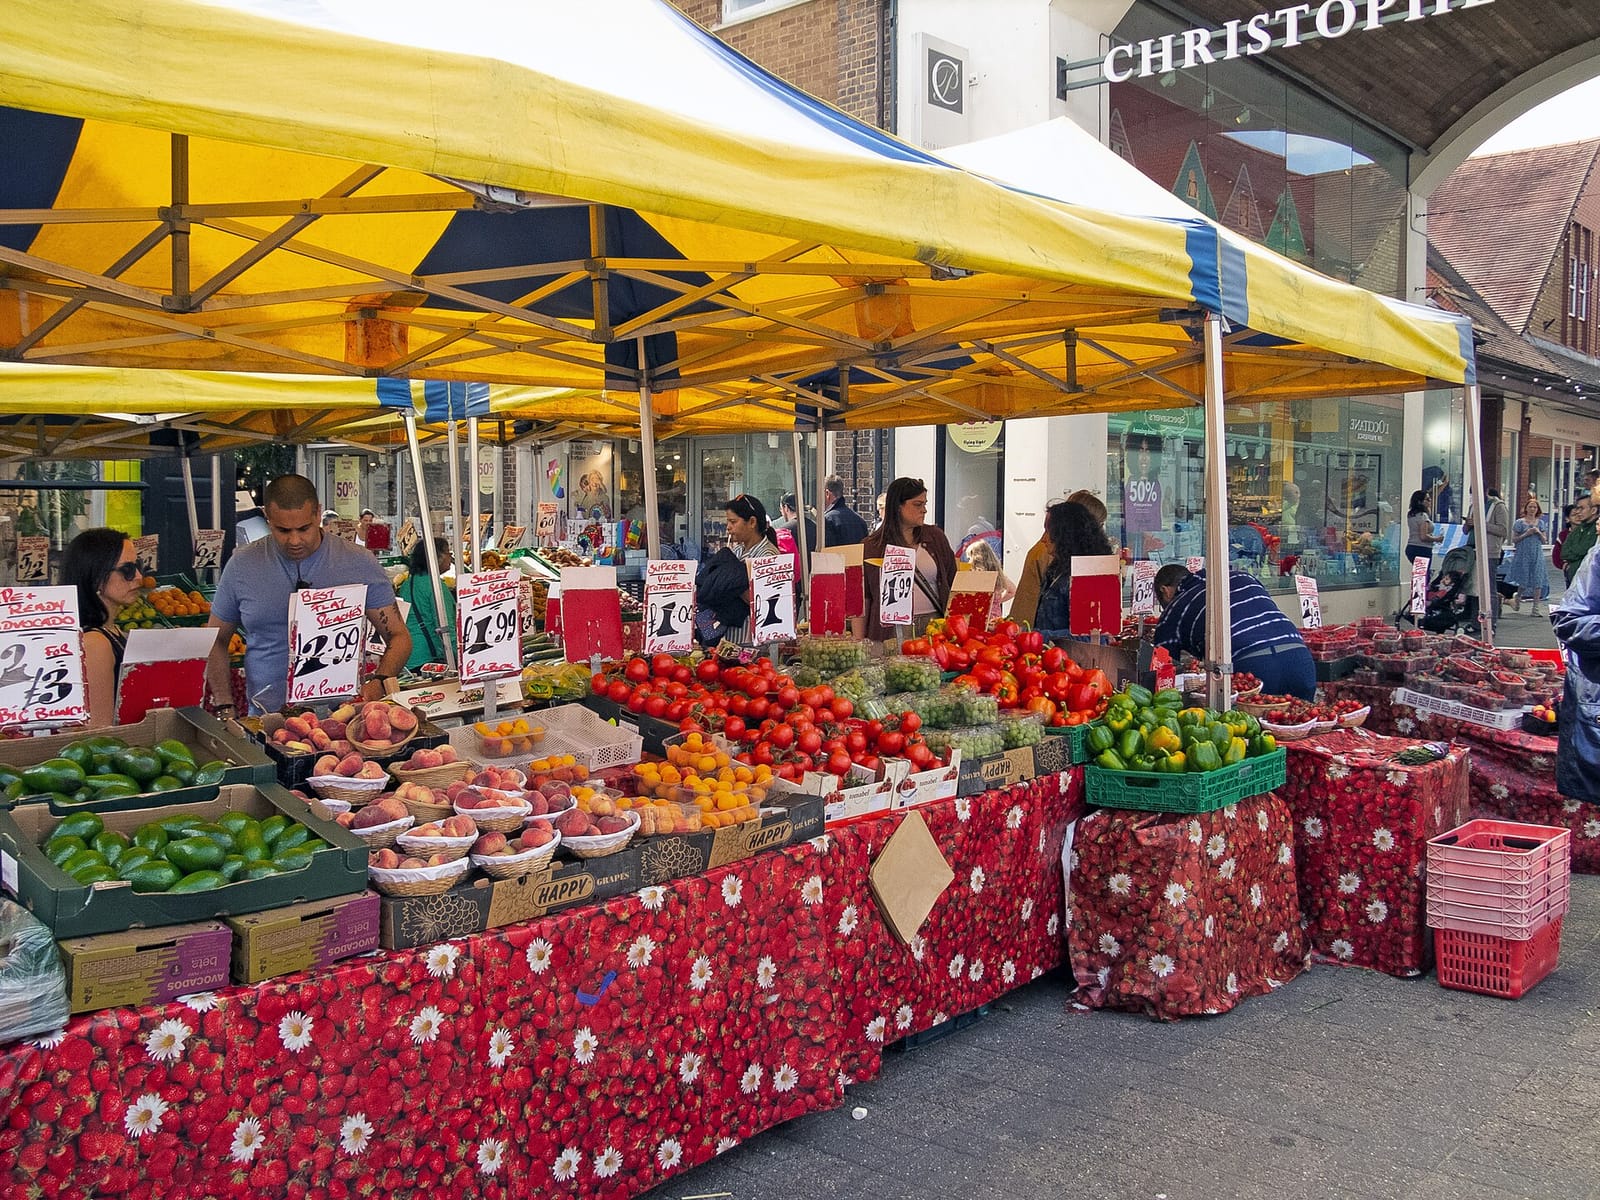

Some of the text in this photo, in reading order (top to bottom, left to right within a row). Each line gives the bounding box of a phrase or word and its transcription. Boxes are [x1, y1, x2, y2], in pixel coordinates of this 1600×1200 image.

[1103, 0, 1496, 83] CHRISTOP
[337, 481, 359, 497] 50%
[1129, 480, 1158, 502] 50%
[540, 517, 554, 528] 60
[648, 562, 686, 574] SUPERB
[753, 556, 777, 569] SWEET
[470, 571, 510, 584] SWEET
[657, 574, 678, 583] VINE
[301, 590, 335, 602] BEST
[648, 582, 692, 592] TOMATOES
[881, 577, 911, 606] £1.99
[8, 600, 65, 615] READY
[311, 599, 347, 613] FLAT
[316, 604, 363, 627] PEACHES
[463, 609, 516, 655] £1.99
[294, 627, 360, 677] £2.99
[0, 643, 35, 688] 2
[22, 667, 73, 710] £3
[319, 679, 354, 696] POUND
[984, 762, 1011, 778] HAPPY
[748, 816, 819, 850] HAPPY GRAPES
[538, 871, 630, 905] HAPPY GRAPES
[327, 935, 376, 957] AVOCADOS
[166, 972, 225, 991] AVOCADOS
